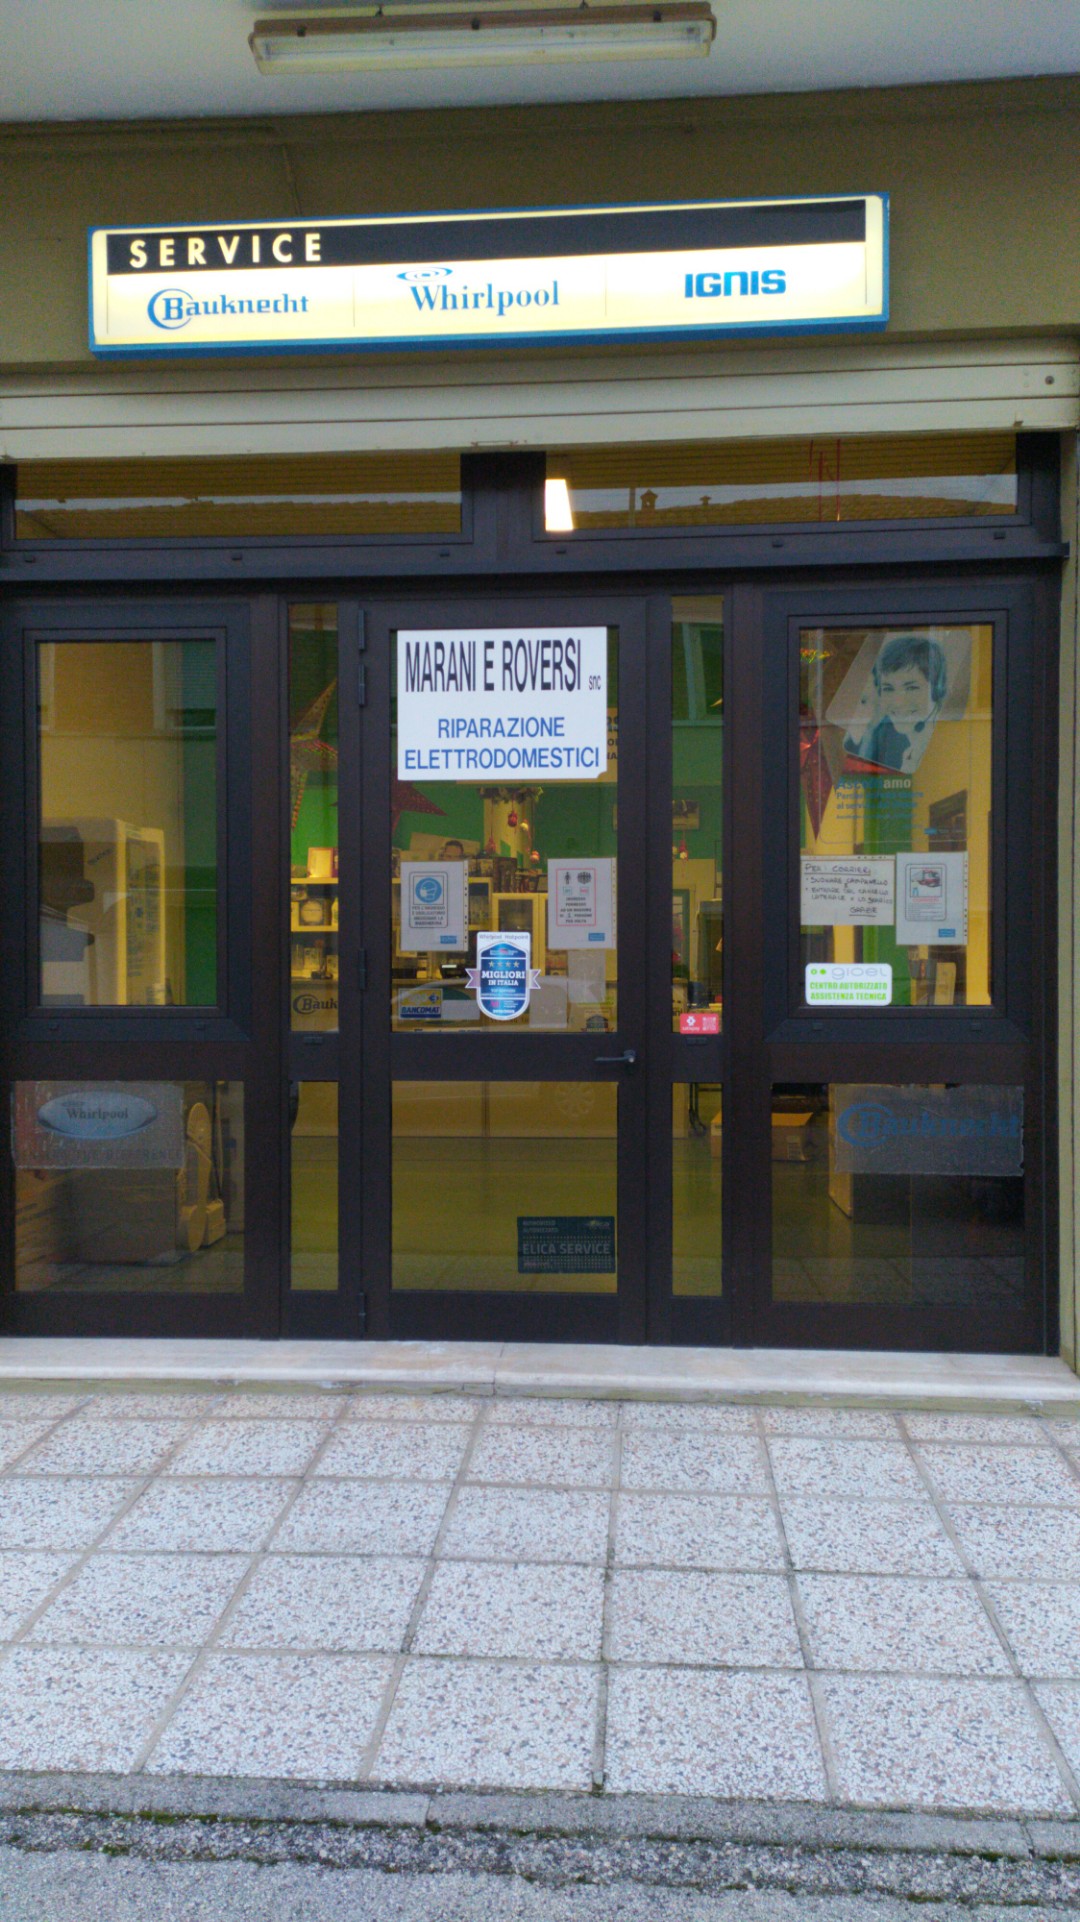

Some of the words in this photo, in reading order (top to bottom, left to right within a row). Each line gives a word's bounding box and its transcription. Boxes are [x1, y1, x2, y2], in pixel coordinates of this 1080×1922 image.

[129, 233, 322, 268] SERVICE
[409, 281, 560, 316] Whirlpool
[156, 290, 309, 327] Bauknecht
[405, 640, 477, 692] MARANI
[484, 640, 495, 691] E
[502, 637, 582, 692] ROVERSI
[588, 674, 602, 690] snc
[438, 716, 566, 739] RIPARAZIONE
[404, 747, 600, 770] ELETTRODOMESTICI
[481, 970, 526, 979] MIGLIORI
[809, 982, 838, 990] CENTRO
[839, 982, 888, 990] AUTORIZZATO
[810, 992, 855, 1000] ASSISTENZA
[855, 992, 887, 1000] TECNICA
[401, 1006, 441, 1014] BANCOMAT
[66, 1107, 129, 1121] Whirlpool
[522, 1243, 557, 1255] ELICA
[559, 1243, 611, 1255] SERVICE
